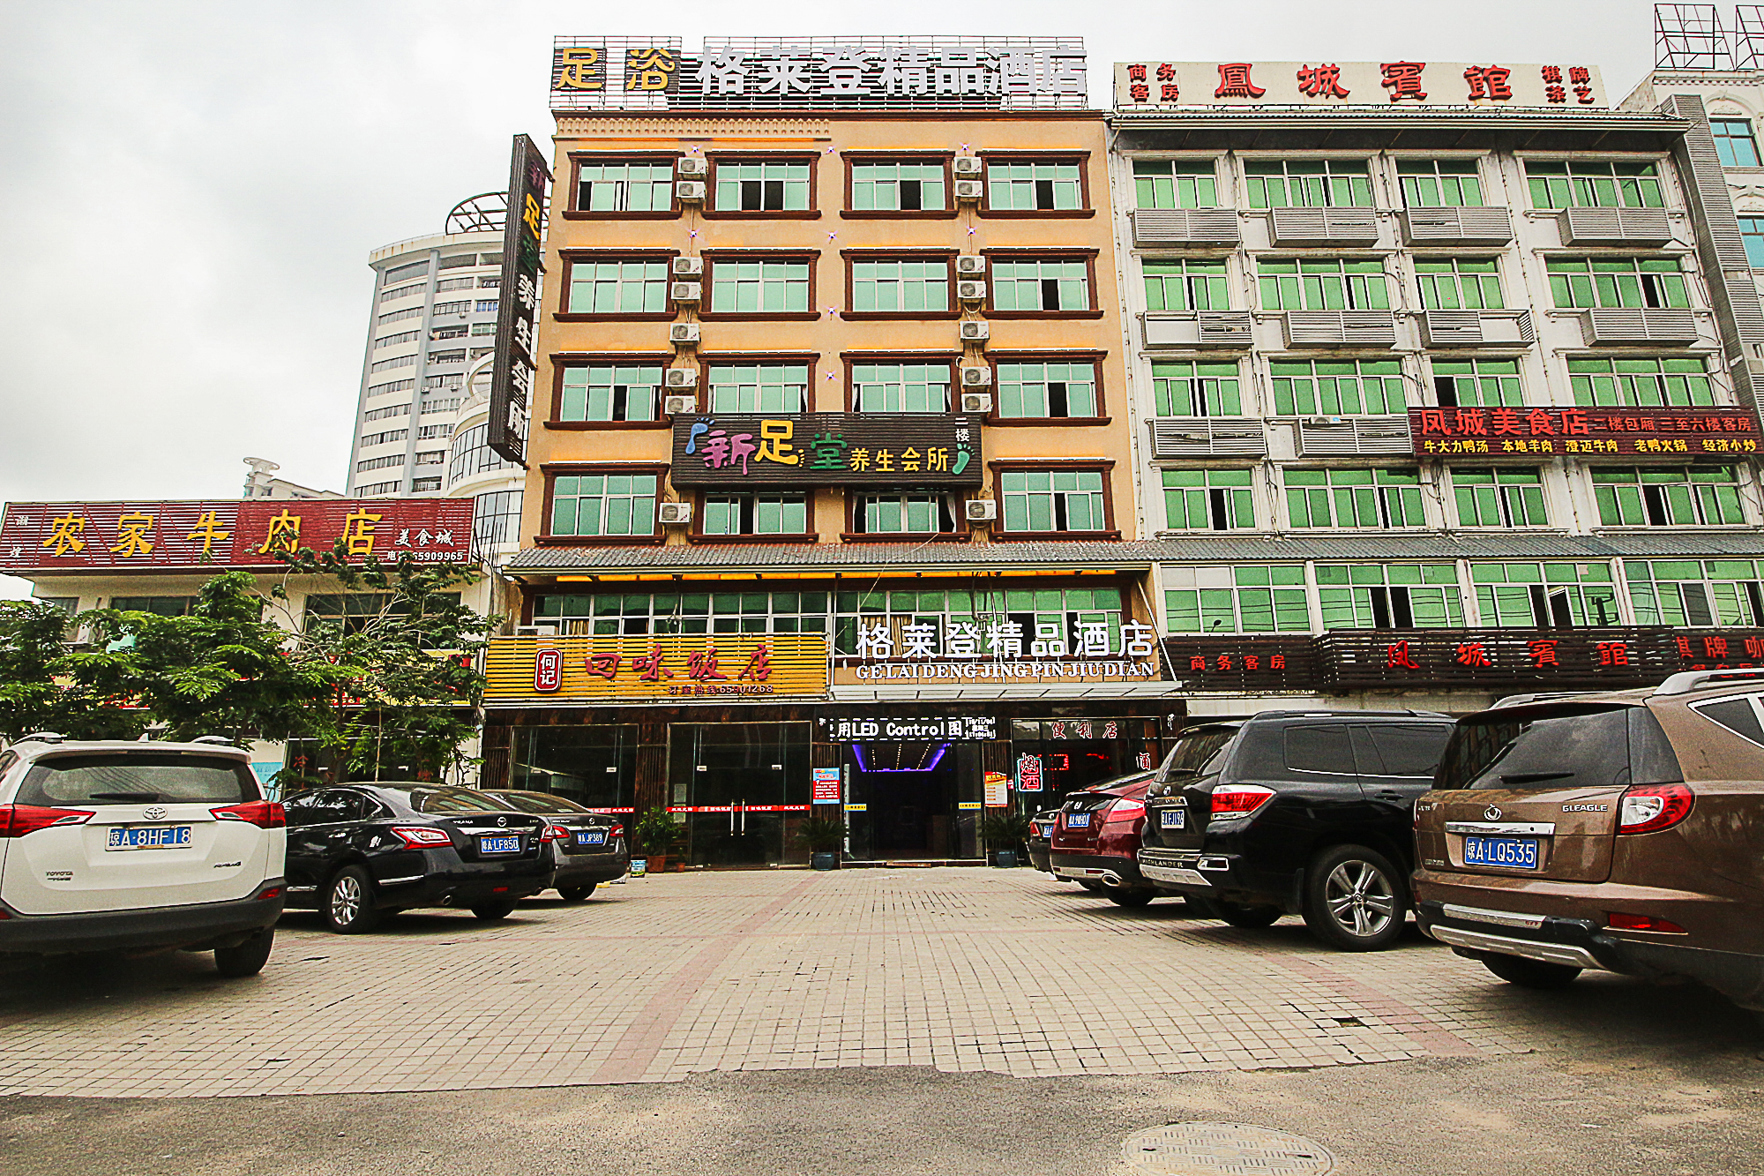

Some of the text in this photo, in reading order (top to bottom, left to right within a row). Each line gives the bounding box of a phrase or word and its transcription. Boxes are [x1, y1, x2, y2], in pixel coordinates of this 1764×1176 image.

[555, 46, 676, 91] 足浴
[694, 45, 1088, 97] 格莱登精品酒店
[1127, 63, 1177, 83] 商务
[1541, 65, 1591, 85] 棋牌
[1129, 83, 1180, 102] 客房
[1545, 85, 1595, 104] 茶艺
[954, 417, 971, 442] 二楼
[1420, 408, 1752, 436] 凤城美食店 二楼包厢 三至六楼客房
[702, 419, 949, 475] 新足堂 养生会所
[1424, 439, 1757, 453] 牛大力鸭汤 本地羊肉 澄迈牛肉 老鸭火锅 经济小炒
[42, 508, 382, 558] 农家牛肉店
[394, 528, 455, 548] 美食城
[856, 620, 1154, 660] 格莱登精品酒店
[540, 654, 558, 685] 何记
[584, 643, 773, 681] 回味饭店
[1189, 654, 1286, 671] 商务客房
[886, 720, 945, 737] Control
[1052, 716, 1118, 740] 便利店
[1562, 804, 1608, 812] GLEAGLE
